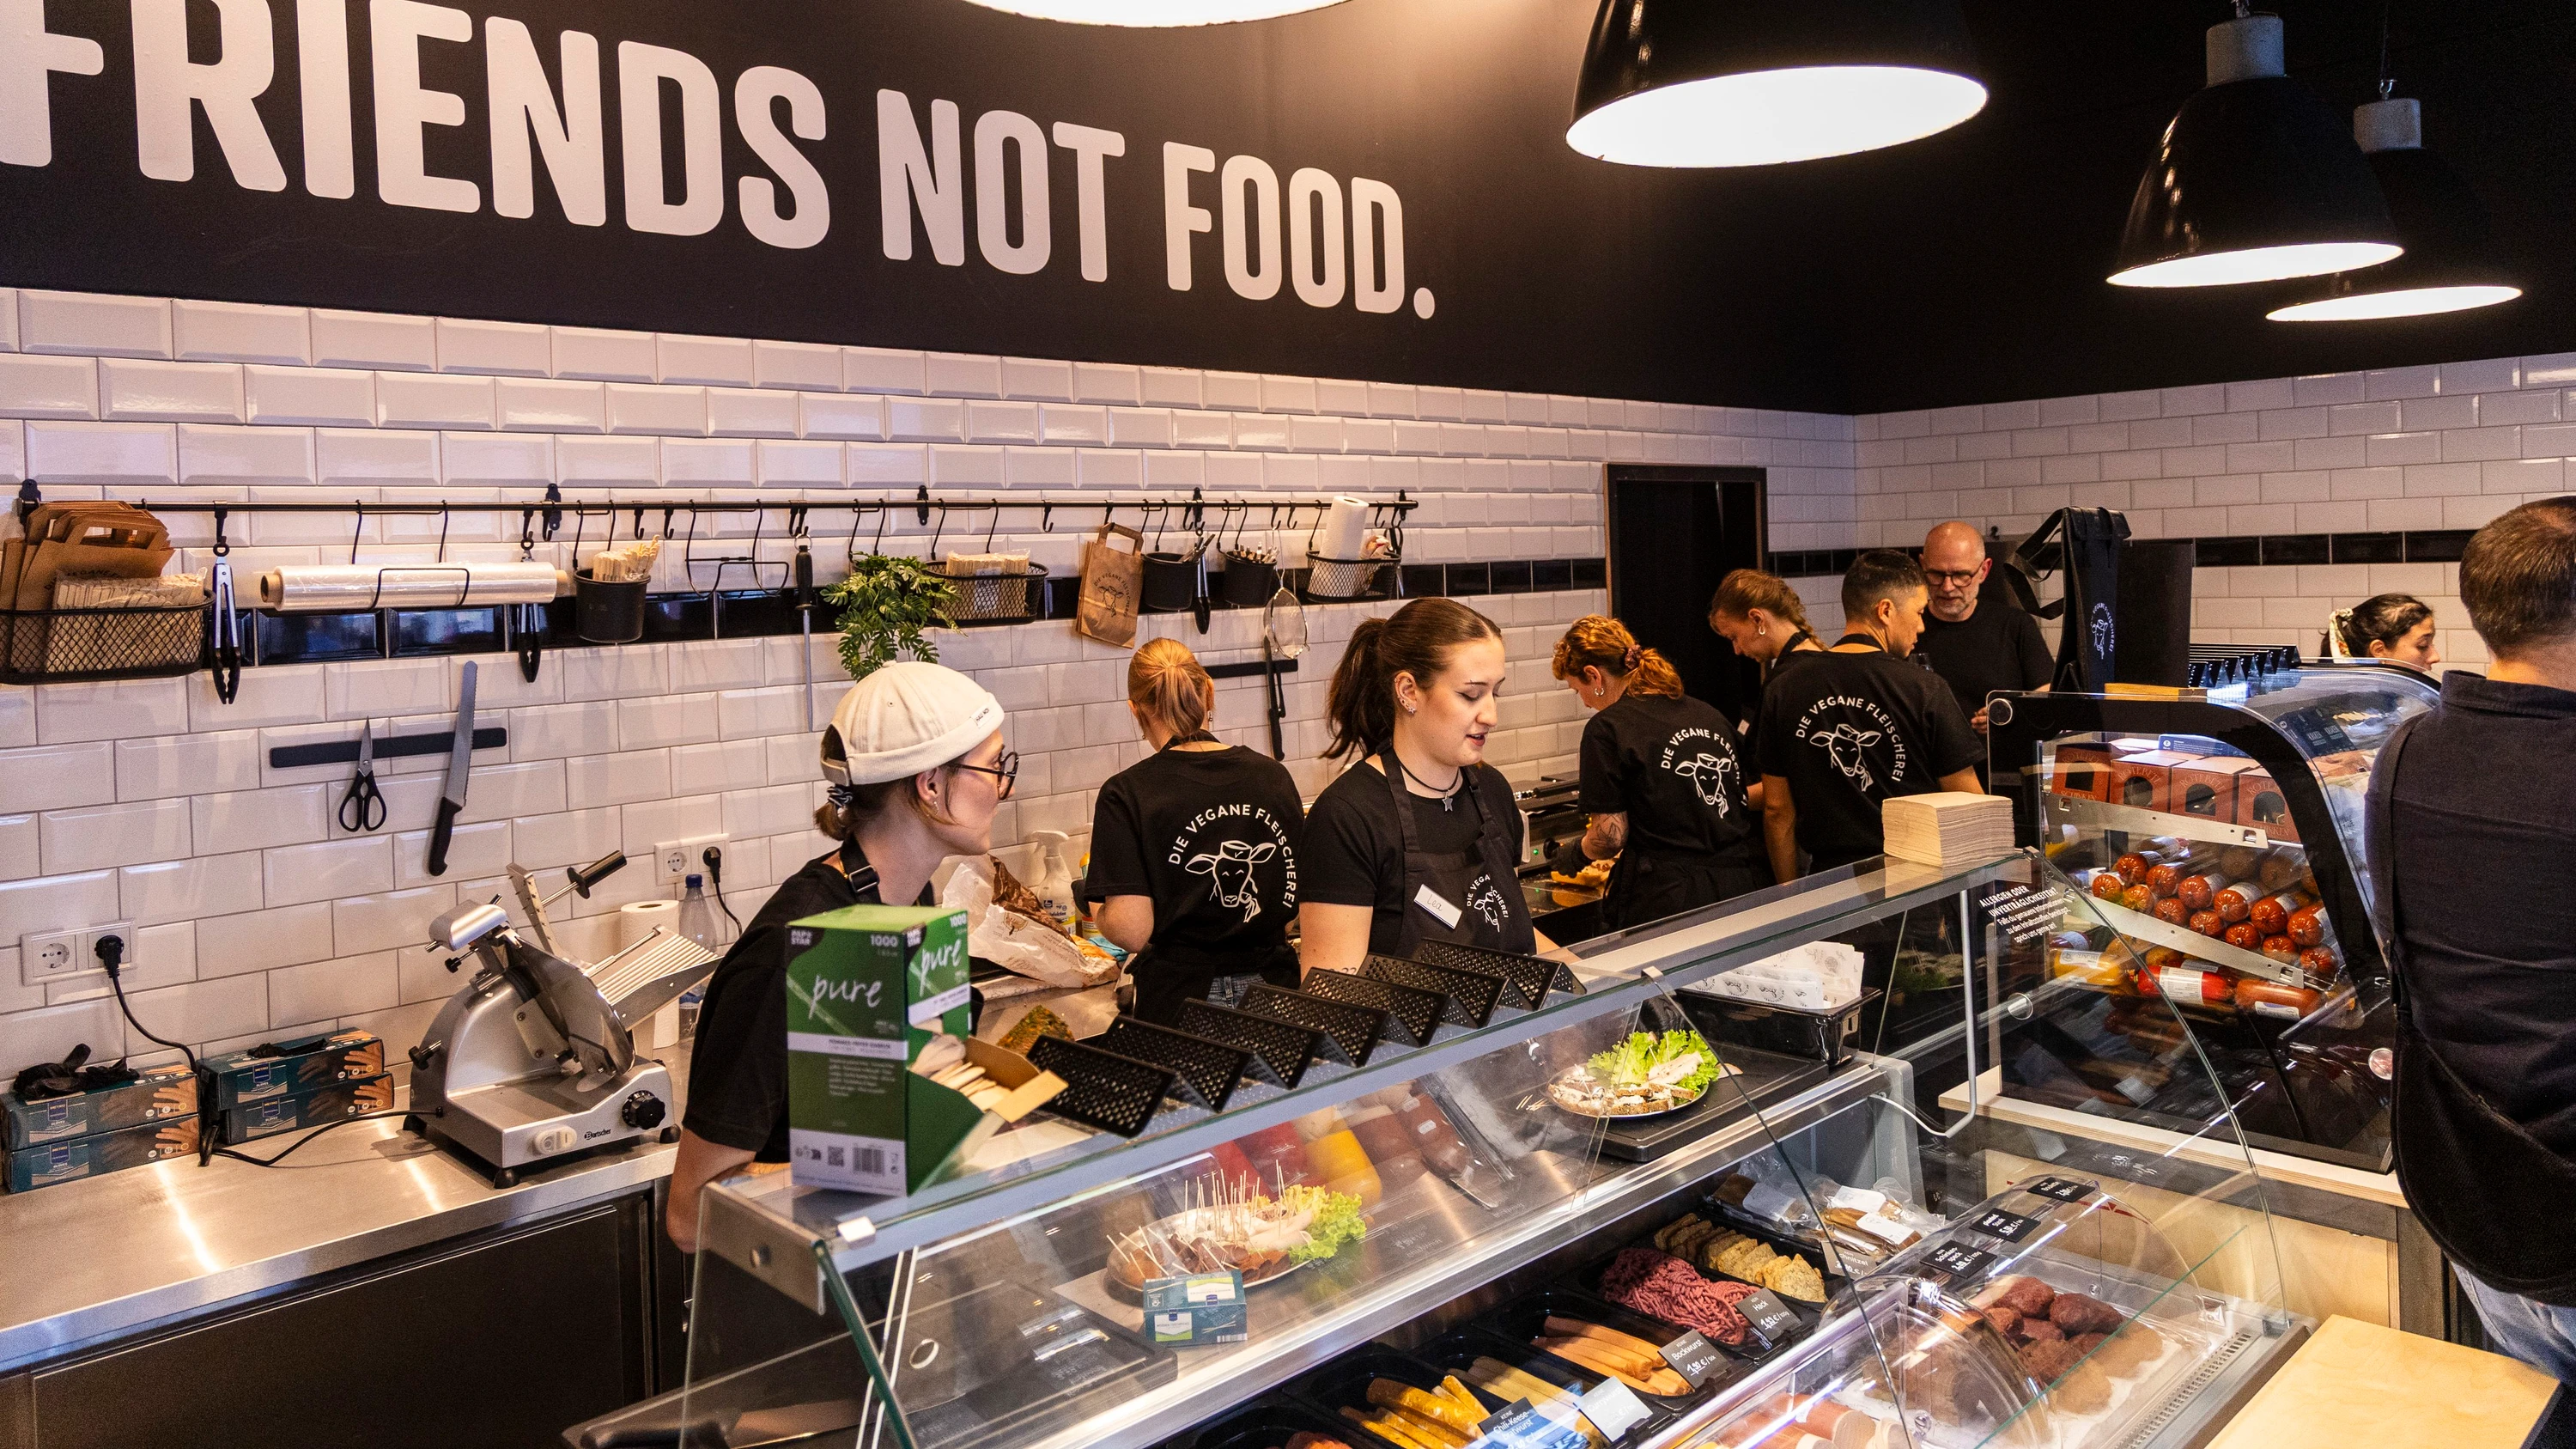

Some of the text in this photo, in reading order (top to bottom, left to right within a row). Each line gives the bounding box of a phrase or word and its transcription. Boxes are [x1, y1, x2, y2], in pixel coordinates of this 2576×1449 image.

[0, 0, 1436, 320] FRIENDS NOT FOOD.
[1102, 572, 1121, 582] VEGANE
[1795, 695, 1906, 782] DIE VEGANE FLEISCHEREI
[1661, 747, 1674, 769] DIE
[1669, 728, 1710, 746] VEGANE
[1169, 804, 1297, 909] DIE VEGANE FLEISCHEREI
[1470, 874, 1491, 891] VEGA
[1426, 894, 1443, 911] Lea
[1978, 885, 2031, 908] ALLERGIEN ODER
[1988, 886, 2059, 917] UNVERTRÄGLICHKEITEN?
[950, 914, 966, 928] 1000
[1996, 916, 2010, 926] Falls
[2008, 914, 2017, 922] du
[2012, 922, 2023, 933] den
[871, 935, 898, 947] 1000
[2014, 933, 2032, 944] sprich
[2028, 929, 2038, 939] uns
[920, 939, 962, 997] pure
[808, 975, 883, 1020] pure
[585, 1129, 611, 1140] Bartscher
[1838, 1253, 1868, 1266] chnitzel
[1752, 1300, 1769, 1312] Hack
[1671, 1339, 1704, 1361] Bockwurst
[1493, 1411, 1529, 1434] Chili-Keese-
[1500, 1409, 1515, 1420] KEINE
